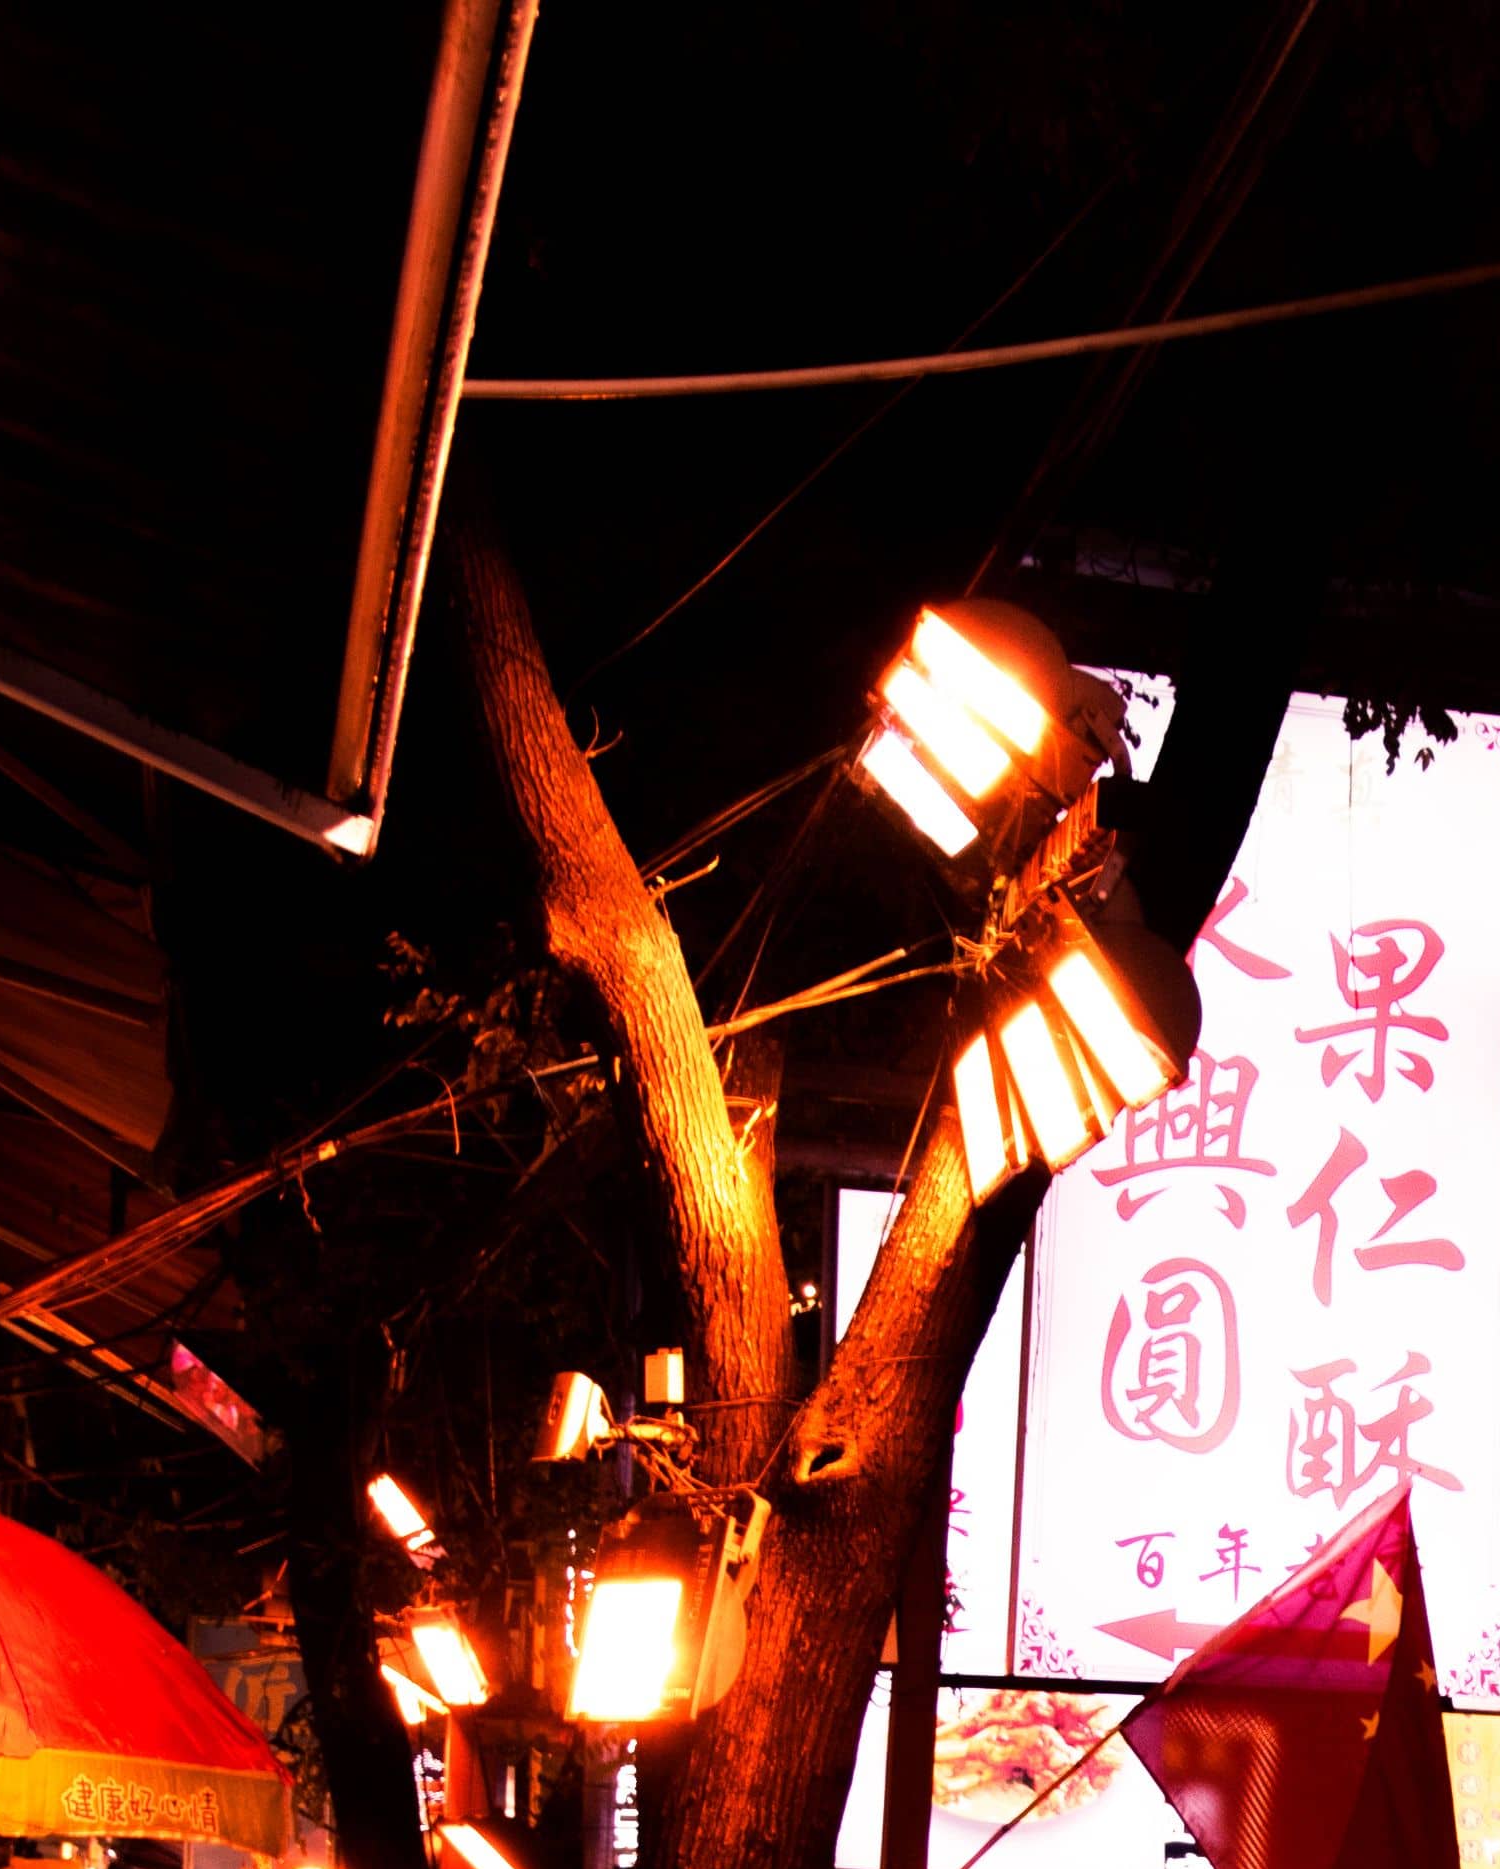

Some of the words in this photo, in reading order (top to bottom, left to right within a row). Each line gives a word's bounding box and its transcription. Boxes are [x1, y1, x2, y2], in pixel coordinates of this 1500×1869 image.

[1286, 921, 1466, 1510] 果仁酥
[62, 1775, 219, 1837] 健康好心情
